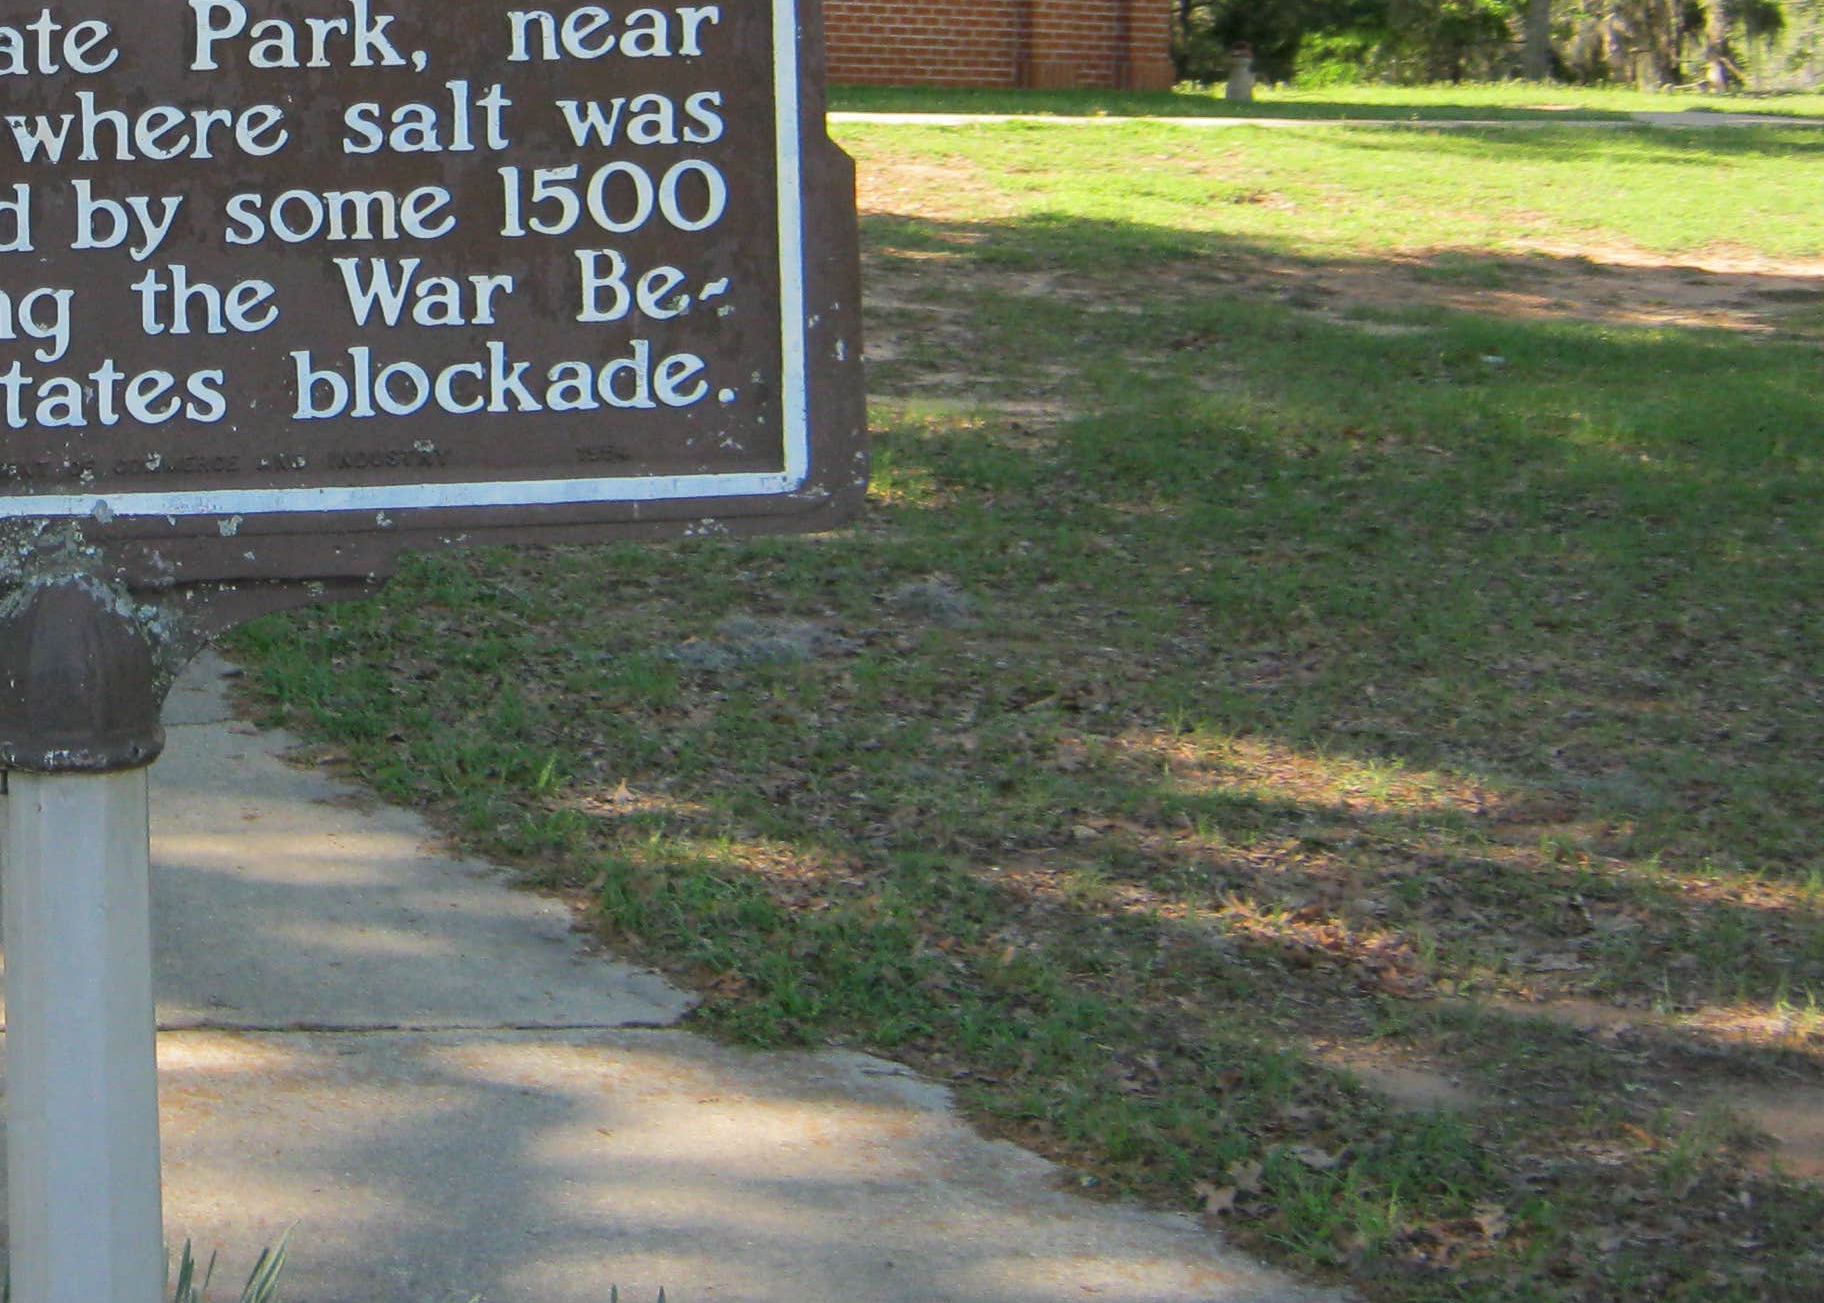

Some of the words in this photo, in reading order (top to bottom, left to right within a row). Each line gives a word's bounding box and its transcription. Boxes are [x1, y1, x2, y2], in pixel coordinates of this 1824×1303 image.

[506, 5, 719, 61] near
[4, 90, 289, 163] where
[342, 79, 512, 154] salt
[555, 91, 724, 147] was
[70, 179, 184, 262] by
[225, 185, 456, 245] some
[497, 159, 727, 237] 1500
[130, 264, 279, 335] the
[332, 257, 513, 327] War
[574, 248, 729, 322] Be-
[289, 339, 735, 419] blockade.
